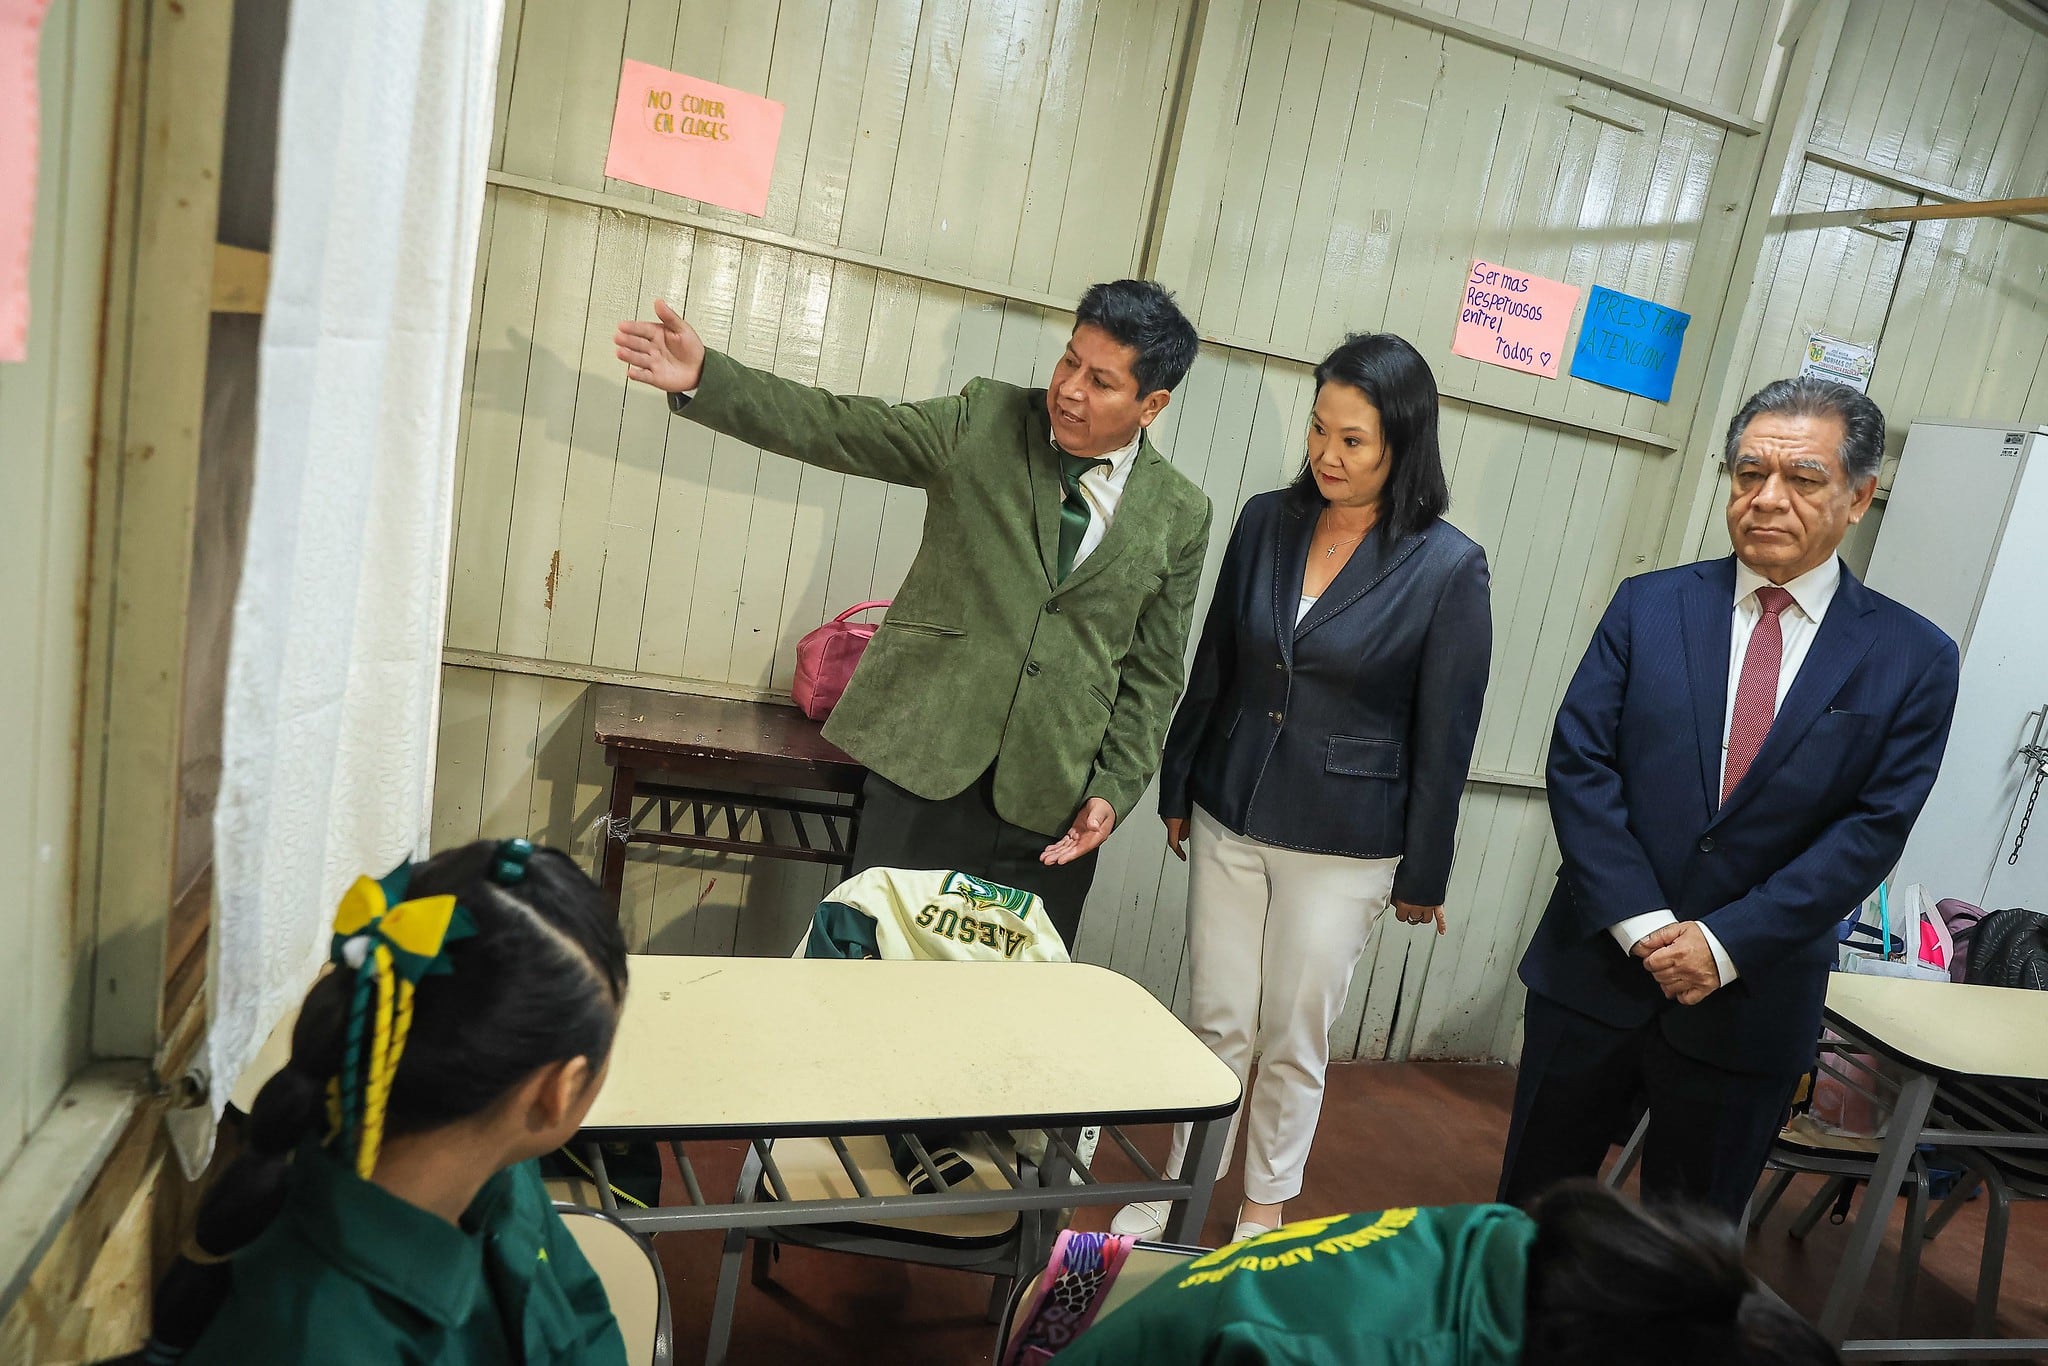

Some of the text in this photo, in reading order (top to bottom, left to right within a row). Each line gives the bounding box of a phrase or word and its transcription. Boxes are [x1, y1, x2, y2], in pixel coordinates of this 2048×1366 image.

[648, 90, 725, 119] NO COMER
[655, 112, 674, 133] EN
[1470, 262, 1529, 293] Ser mas
[1593, 291, 1690, 341] PRESTAR
[1580, 326, 1667, 372] ATENCION
